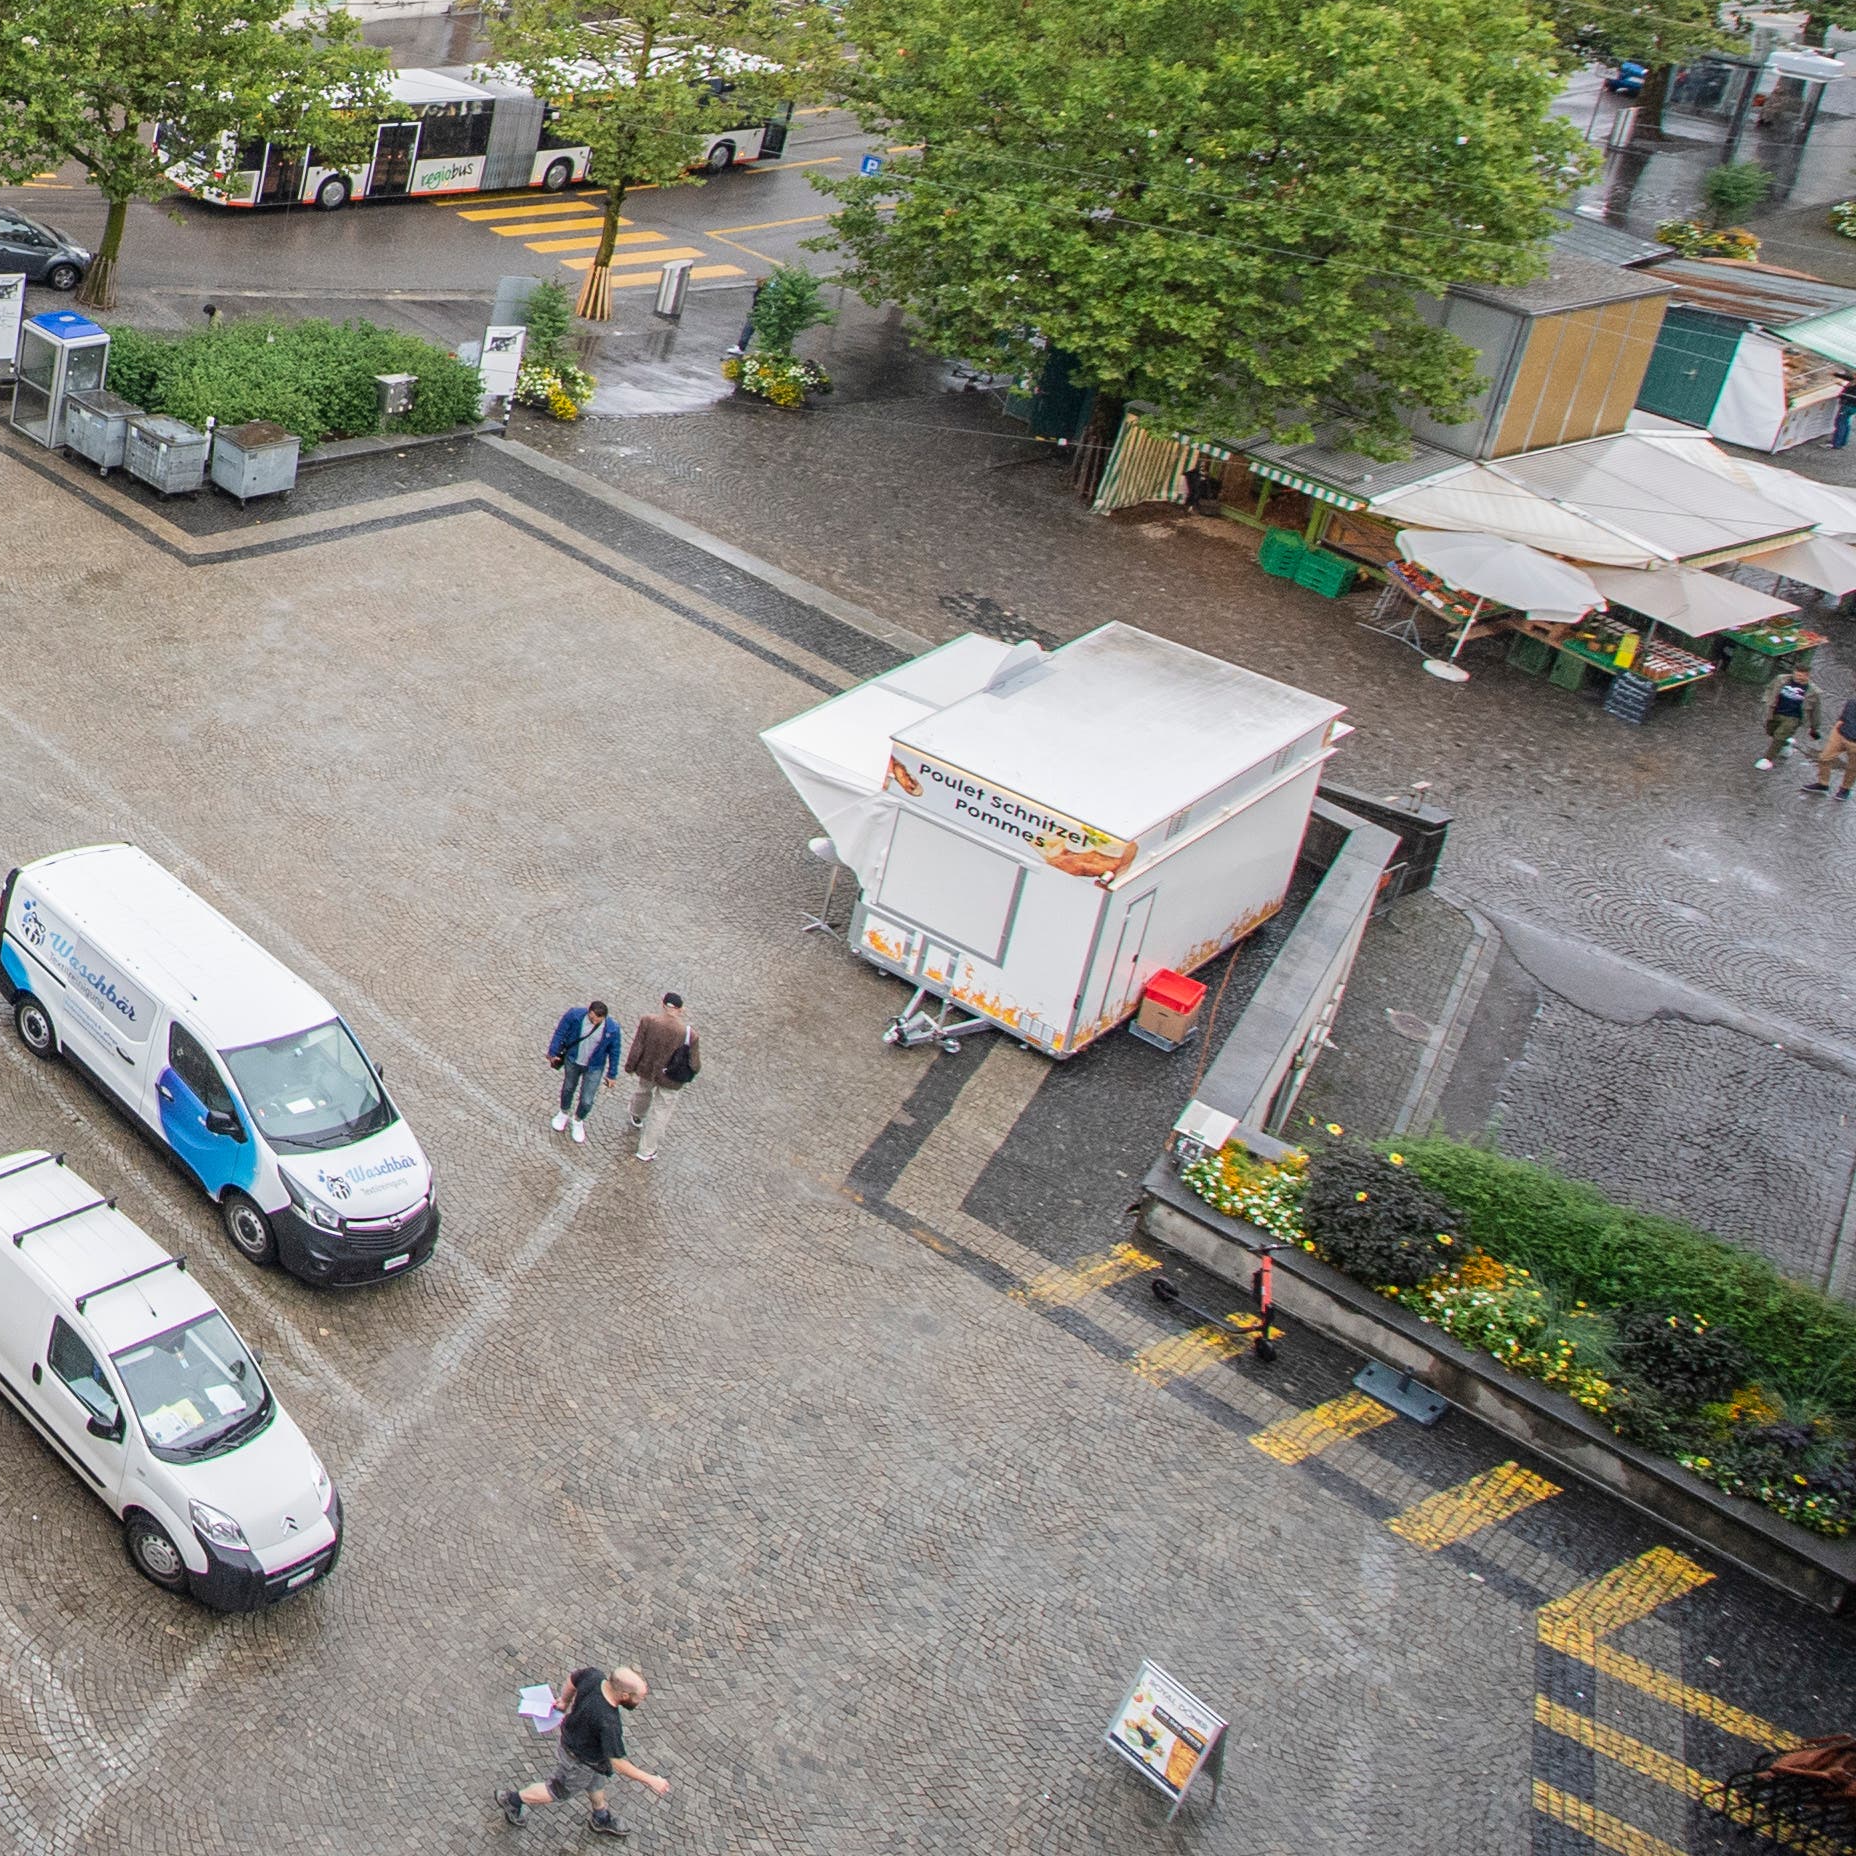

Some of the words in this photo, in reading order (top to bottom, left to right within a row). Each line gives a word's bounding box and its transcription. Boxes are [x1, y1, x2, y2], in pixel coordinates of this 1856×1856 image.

[421, 163, 474, 190] regiobus
[867, 159, 879, 173] P
[918, 763, 986, 801] Poulet
[990, 795, 1088, 848] Schnitzel
[955, 798, 1046, 848] Pommes
[49, 931, 137, 1022] Waschbär
[50, 951, 105, 1011] Textilreinigung
[345, 1155, 418, 1183] Waschbär
[360, 1178, 409, 1196] Textilreinigung
